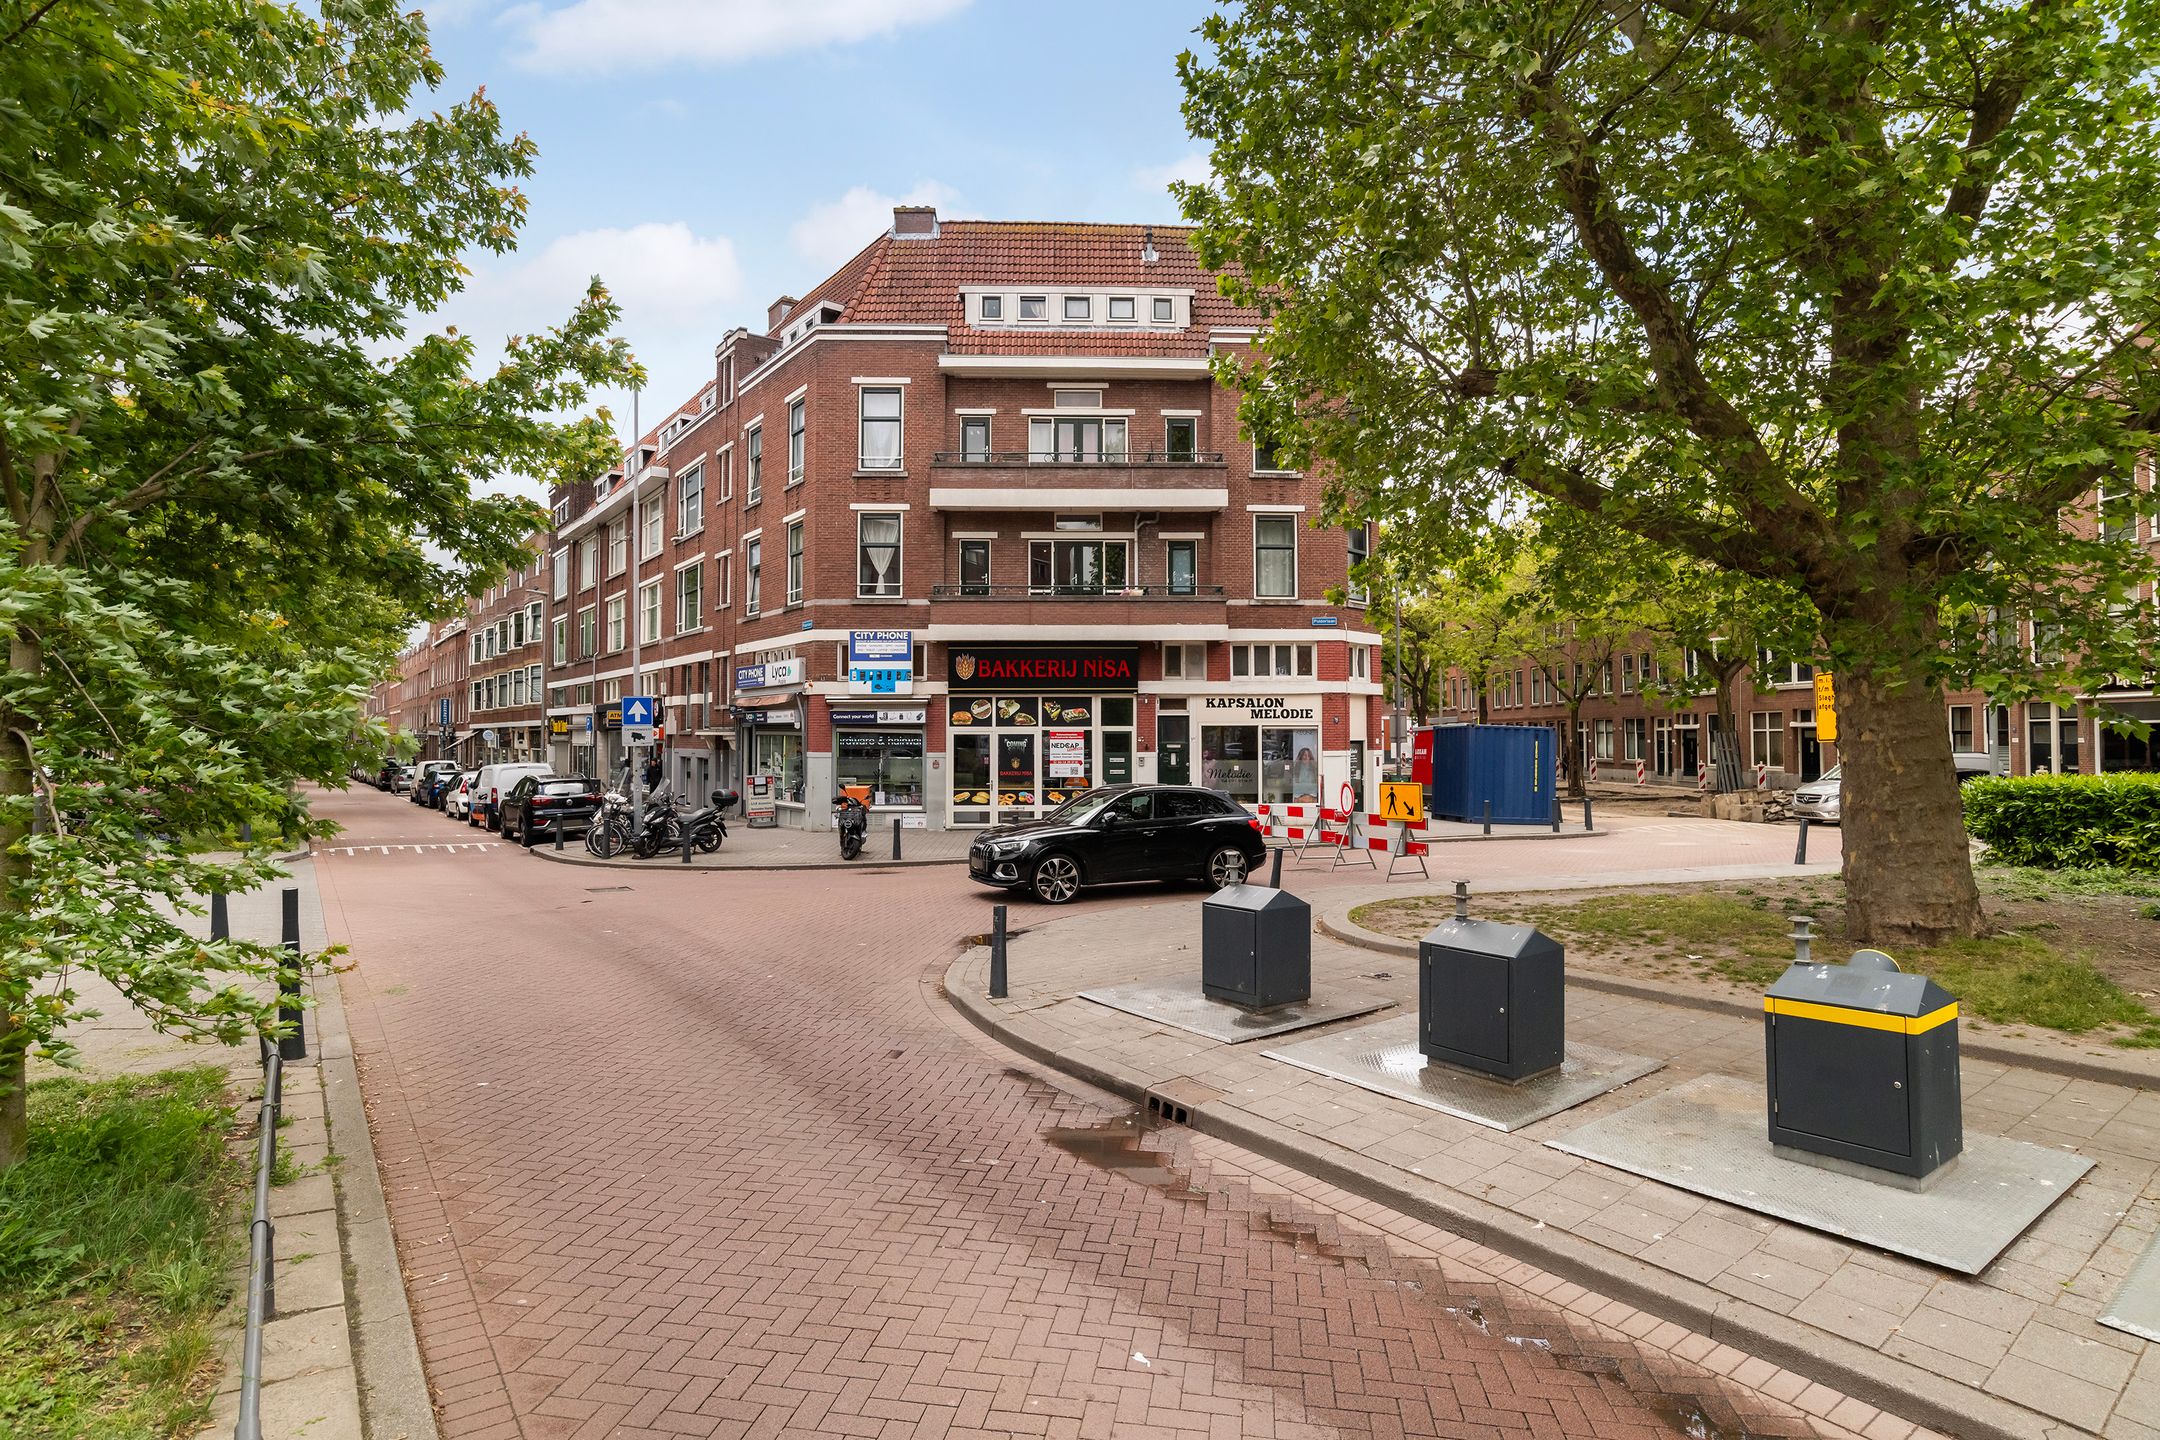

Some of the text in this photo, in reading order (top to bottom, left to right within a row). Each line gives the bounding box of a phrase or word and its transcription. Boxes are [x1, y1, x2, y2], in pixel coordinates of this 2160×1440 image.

[854, 631, 909, 640] CITY PHONE
[738, 667, 764, 680] CITY PHONE
[771, 665, 787, 680] Lyca
[978, 659, 1078, 678] BAKKERIJ
[1205, 698, 1285, 708] KAPSALON
[1250, 708, 1314, 719] MELODIE
[1207, 768, 1253, 779] Melodie
